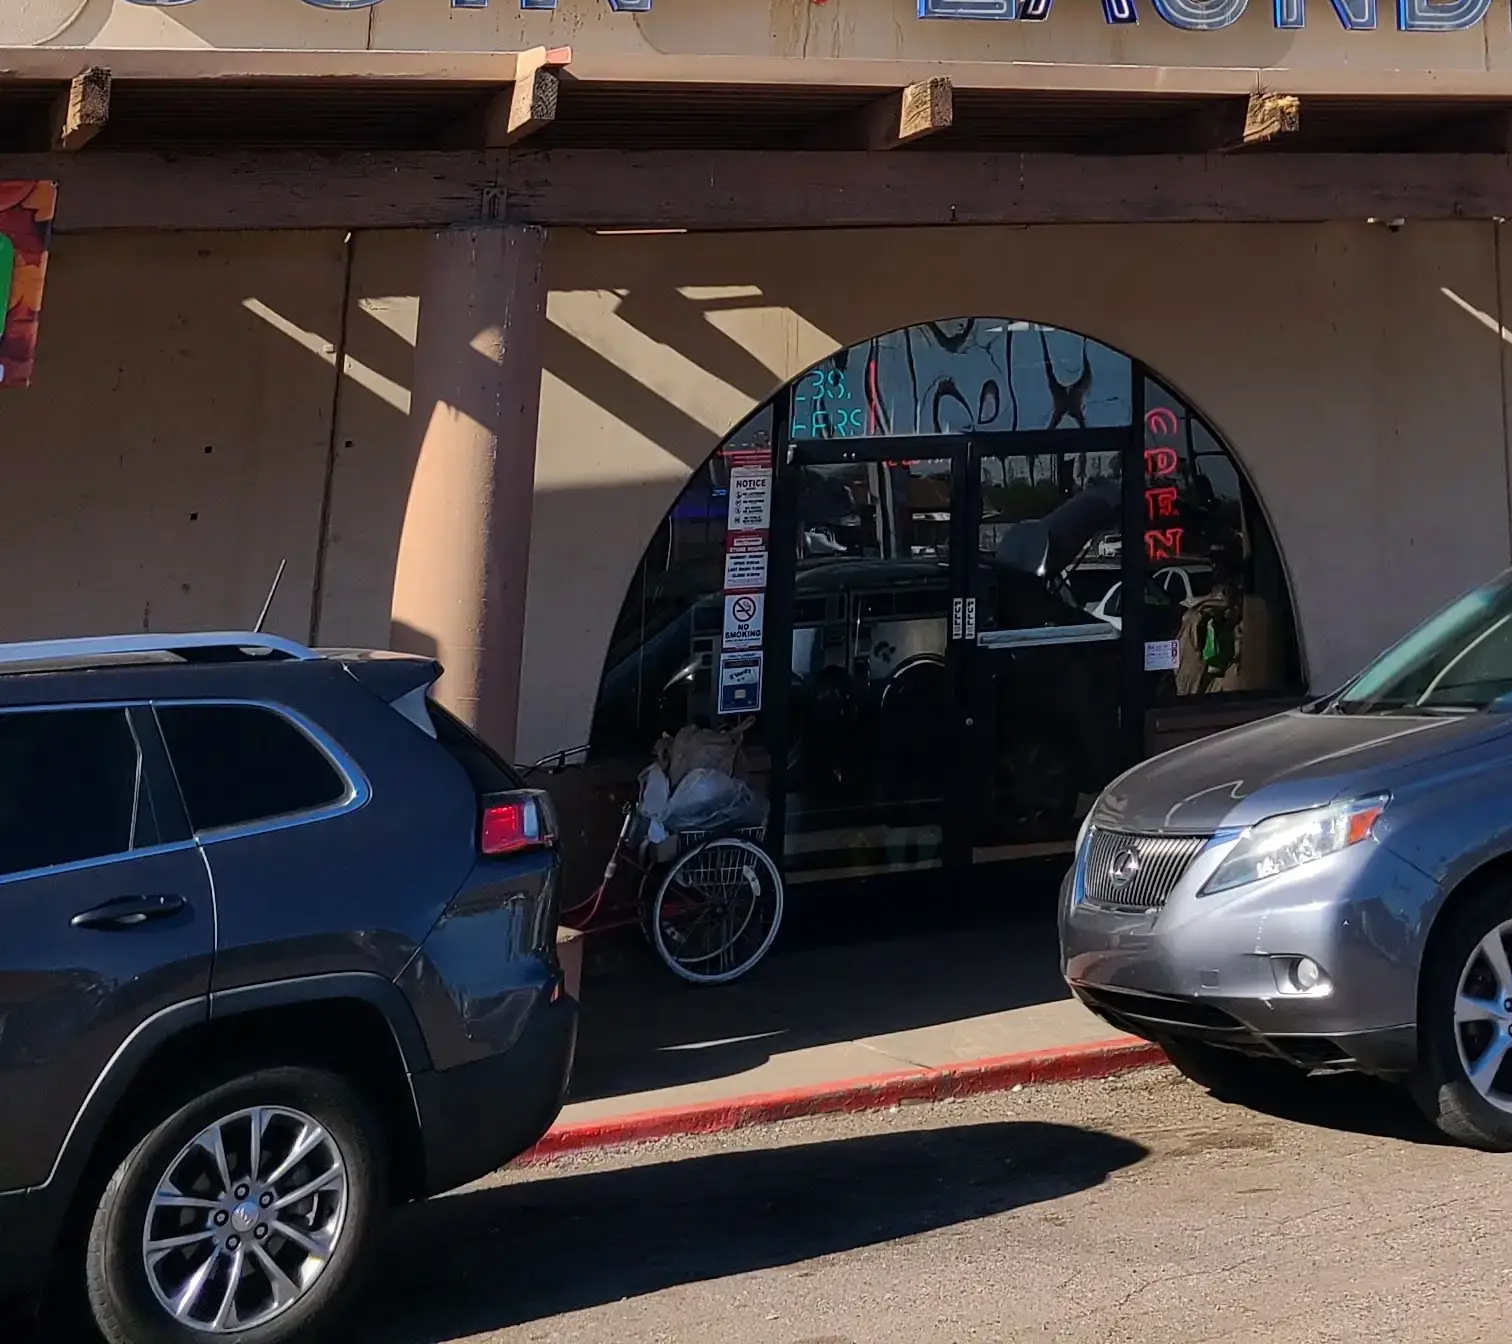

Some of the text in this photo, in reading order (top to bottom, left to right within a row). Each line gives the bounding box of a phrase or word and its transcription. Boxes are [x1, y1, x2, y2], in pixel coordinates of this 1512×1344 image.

[736, 479, 767, 488] NOTICE
[1144, 407, 1183, 560] OPEN
[725, 629, 761, 639] SMOKING
